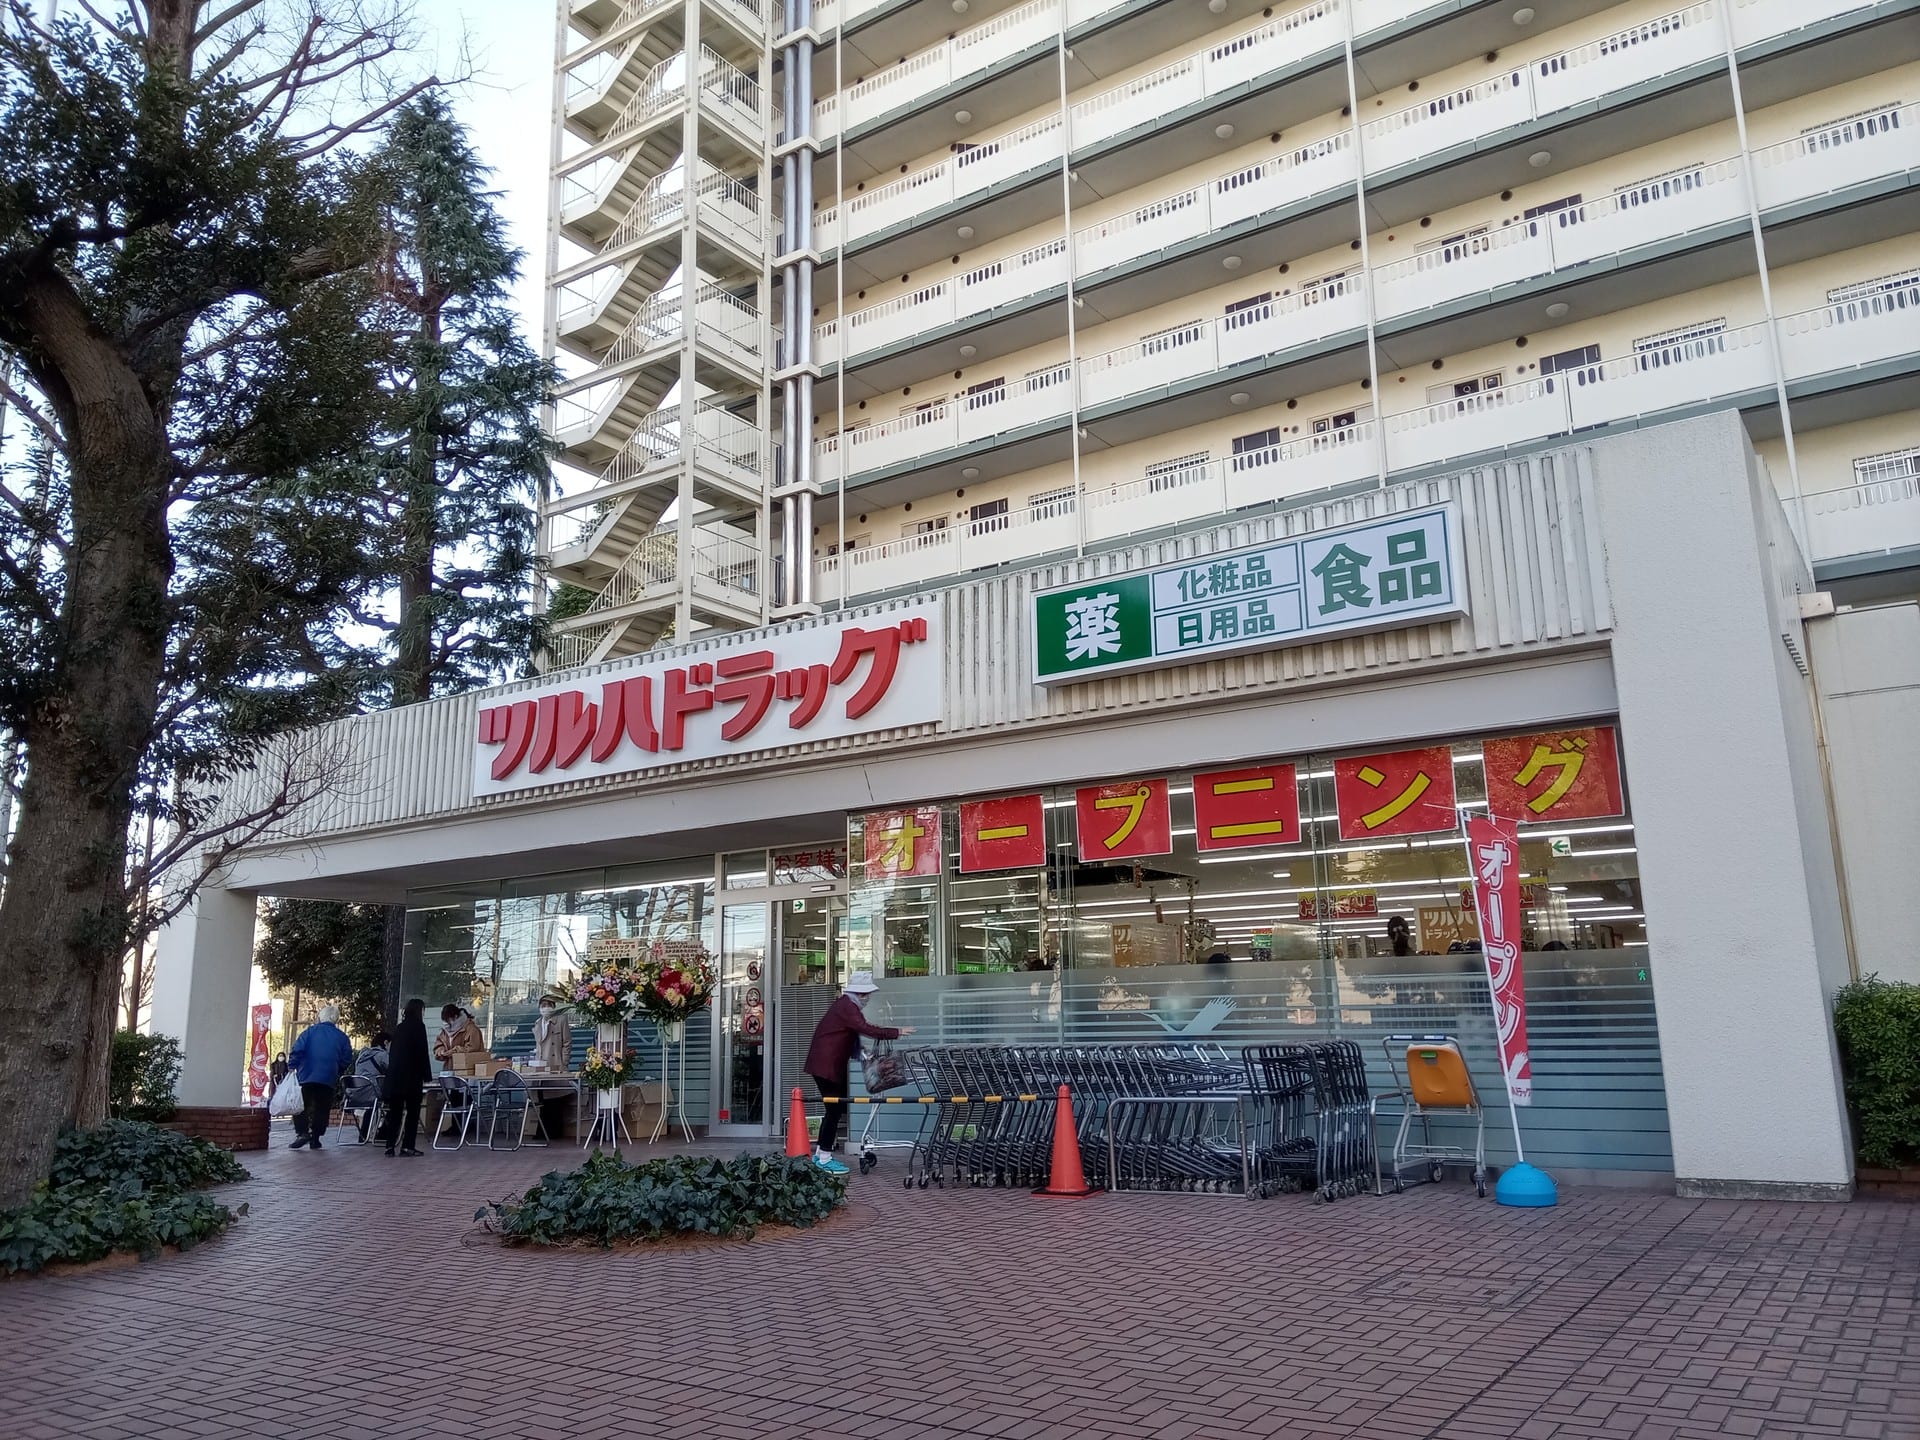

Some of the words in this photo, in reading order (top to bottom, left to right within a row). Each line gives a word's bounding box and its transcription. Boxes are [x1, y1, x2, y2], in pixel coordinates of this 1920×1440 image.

[1177, 555, 1273, 602] 化粧品
[1311, 529, 1442, 616] 食品
[1064, 593, 1121, 662] 薬
[1177, 601, 1275, 646] 日用品
[478, 617, 927, 781] ツルハドラッグ
[879, 737, 1589, 872] オープニング
[774, 848, 848, 873] お客様
[1478, 840, 1521, 1046] オープン
